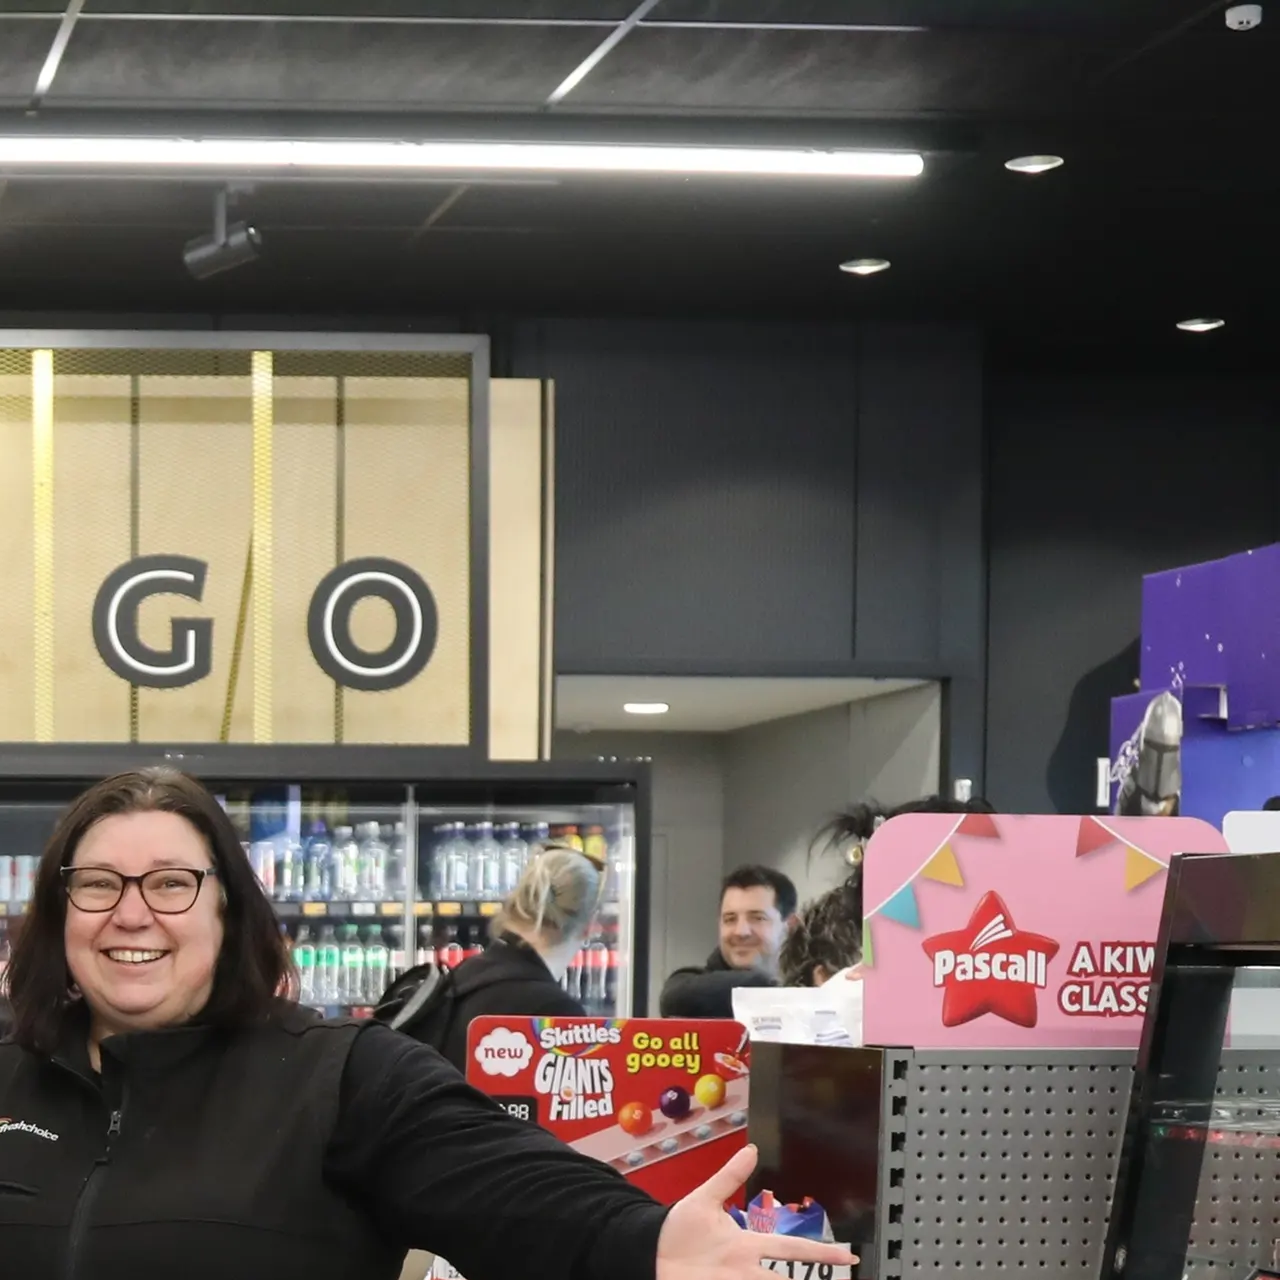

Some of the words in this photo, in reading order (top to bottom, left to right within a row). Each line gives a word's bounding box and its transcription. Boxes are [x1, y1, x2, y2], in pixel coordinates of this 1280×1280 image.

[92, 553, 439, 693] GO
[932, 949, 1048, 988] Pascall
[1071, 943, 1095, 974] A
[1104, 942, 1158, 974] KIW
[1060, 986, 1150, 1015] CLASS
[539, 1023, 621, 1050] Skittles
[632, 1032, 664, 1051] Go
[669, 1032, 699, 1051] all
[483, 1045, 524, 1060] new
[626, 1052, 701, 1074] gooey
[534, 1053, 614, 1096] GIANTS
[549, 1094, 614, 1121] Filled
